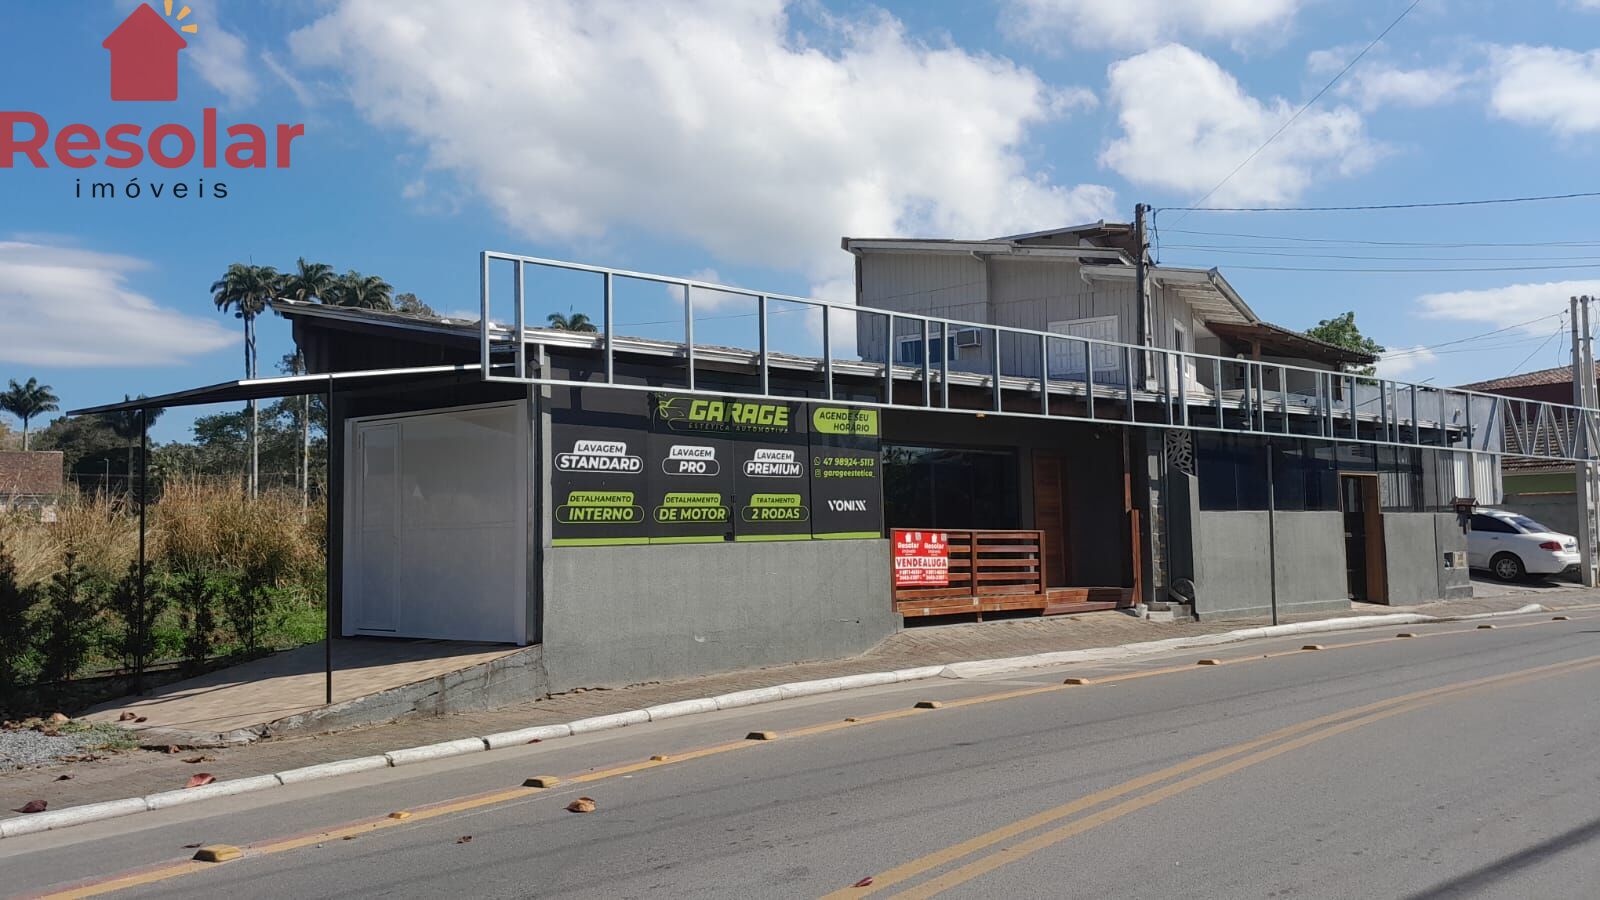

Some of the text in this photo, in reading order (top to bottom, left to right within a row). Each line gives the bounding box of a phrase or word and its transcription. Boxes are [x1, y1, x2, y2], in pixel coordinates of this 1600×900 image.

[688, 400, 789, 426] GARAGE
[820, 411, 869, 422] AGENDE SEU
[577, 443, 623, 454] LAVAGEM
[672, 449, 712, 458] LAVAGEM
[757, 452, 792, 460] LAVAGEM
[560, 455, 640, 471] STANDARD
[679, 461, 706, 473] PRO
[823, 457, 874, 467] 47 98924-5113
[747, 462, 800, 475] PREMIUM
[569, 495, 632, 503] DETALHAMENTO
[665, 496, 719, 504] DETALHAMENTO
[568, 508, 634, 521] INTERNO
[658, 509, 726, 521] DE MOTOR
[751, 508, 800, 519] 2 RODAS
